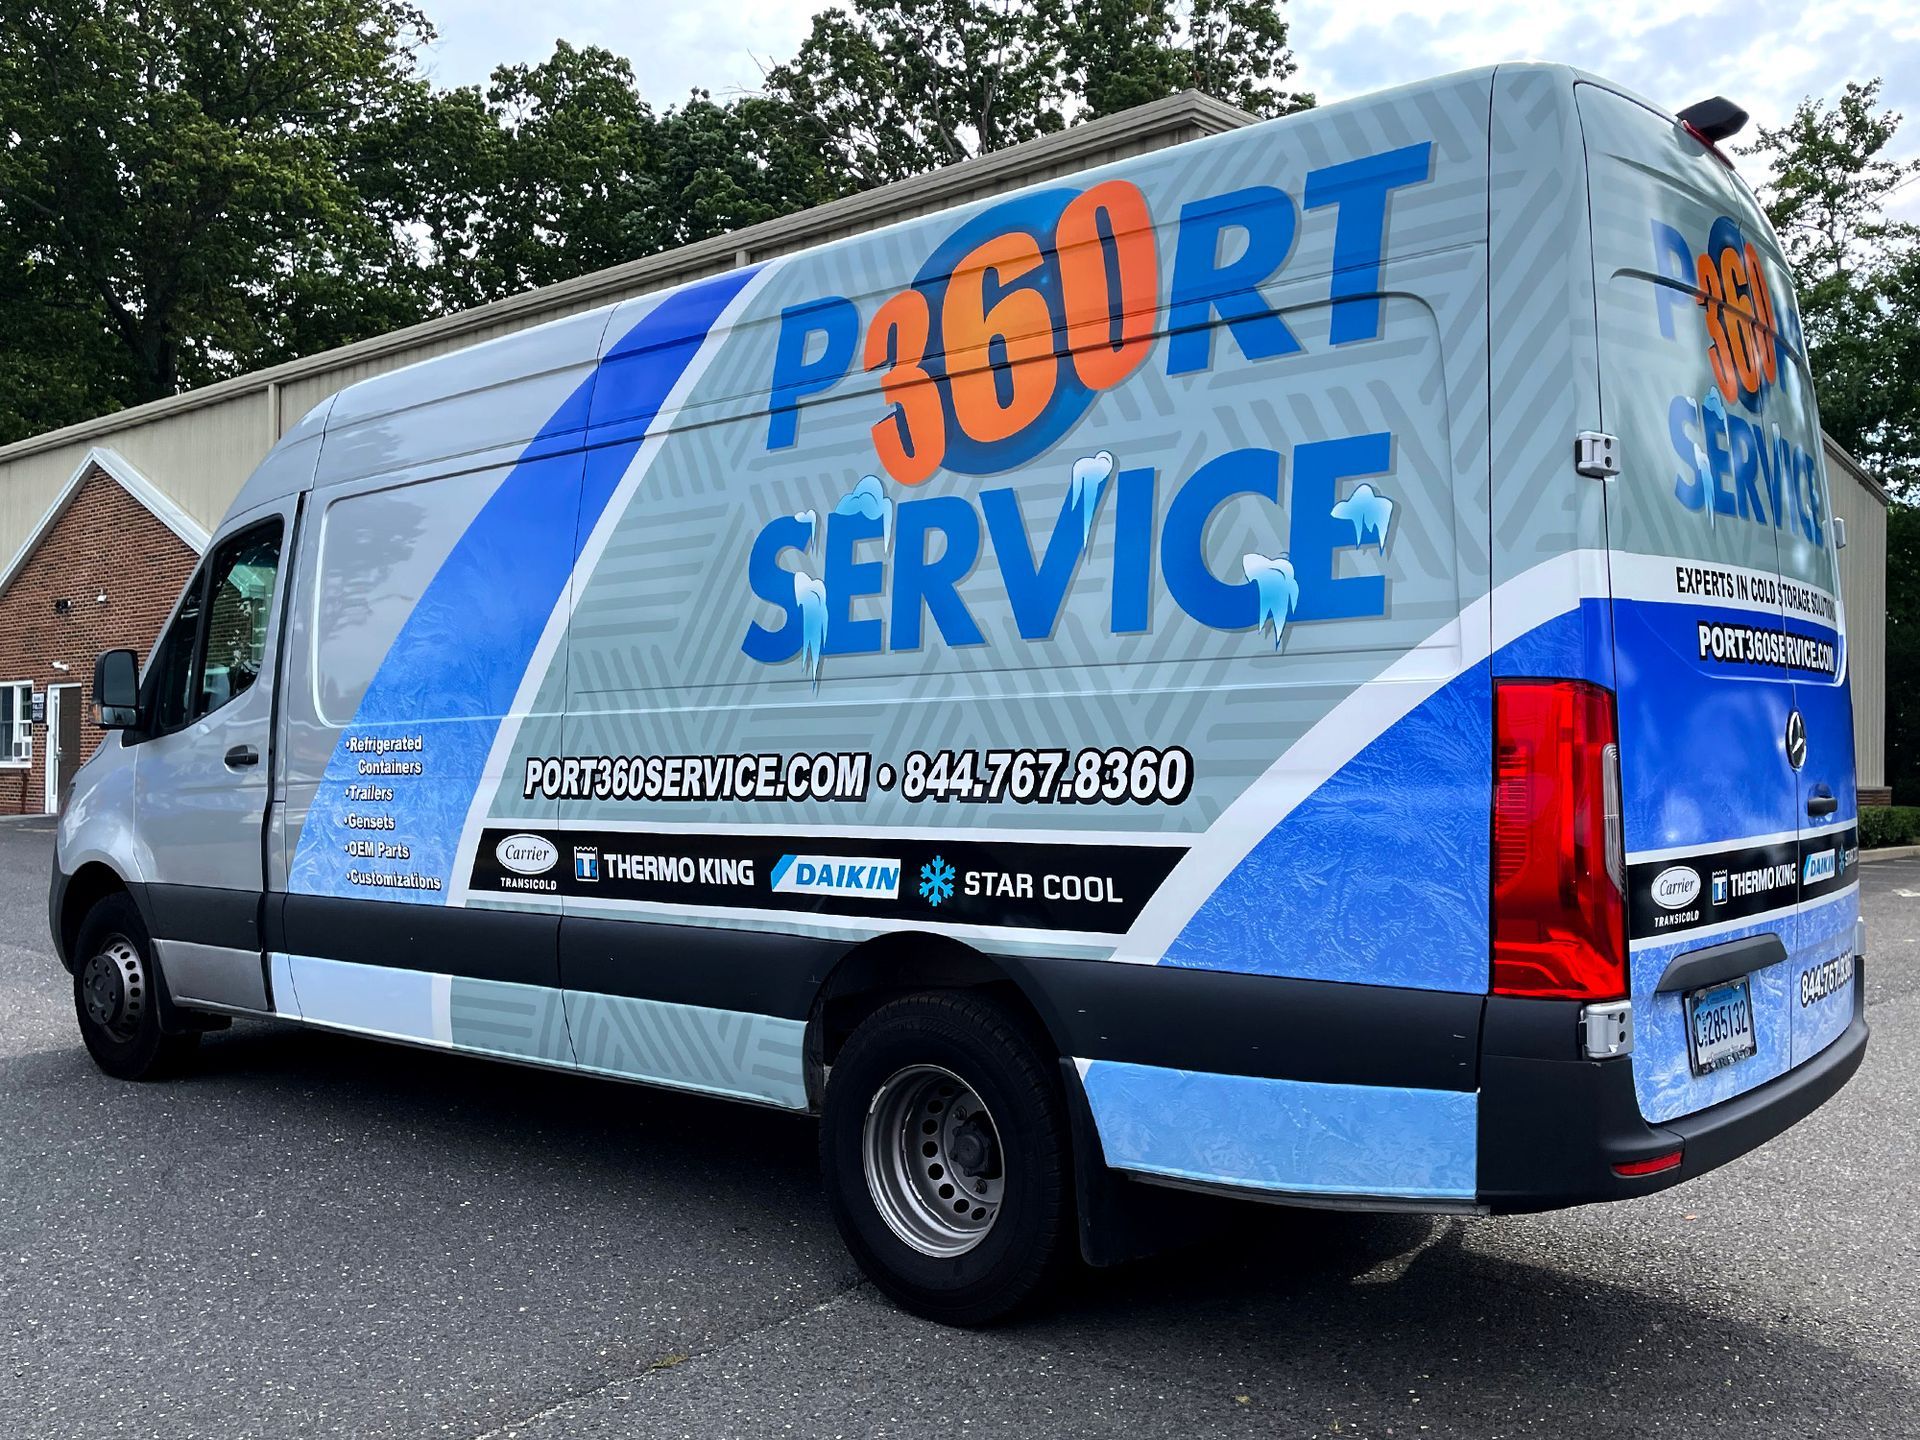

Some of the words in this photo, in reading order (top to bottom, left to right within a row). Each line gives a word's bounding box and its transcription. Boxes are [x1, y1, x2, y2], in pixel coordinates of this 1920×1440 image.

[1669, 394, 1824, 549] SERVICE
[741, 432, 1392, 663] SERVICE
[1676, 566, 1735, 599] EXPERTS
[1736, 574, 1749, 601] IN
[1750, 577, 1776, 605] COLD
[1777, 581, 1811, 613] STORAGE
[1697, 619, 1836, 676] PORT360SERVICE.COM
[349, 734, 423, 755] Refrigerated
[358, 759, 423, 775] Containers
[524, 752, 869, 801] PORT360SERVICE.COM
[902, 745, 1194, 804] 844.767.8360
[349, 785, 394, 801] Trailers
[348, 813, 396, 830] Gensets
[348, 841, 374, 857] OEM
[377, 842, 411, 859] Parts
[505, 844, 550, 862] Carrier
[604, 853, 696, 884] THERMO
[699, 858, 755, 886] KING
[795, 863, 899, 890] DAIKIN
[1811, 855, 1833, 877] DAIKIN
[350, 869, 442, 890] Customizations
[500, 877, 557, 891] TRANSICOLD
[964, 872, 1034, 898] STAR
[1043, 874, 1123, 903] COOL
[1660, 878, 1695, 897] Carrier
[1730, 866, 1774, 898] THERMO
[1776, 862, 1797, 888] KING
[1654, 909, 1700, 928] TRANSICOLD
